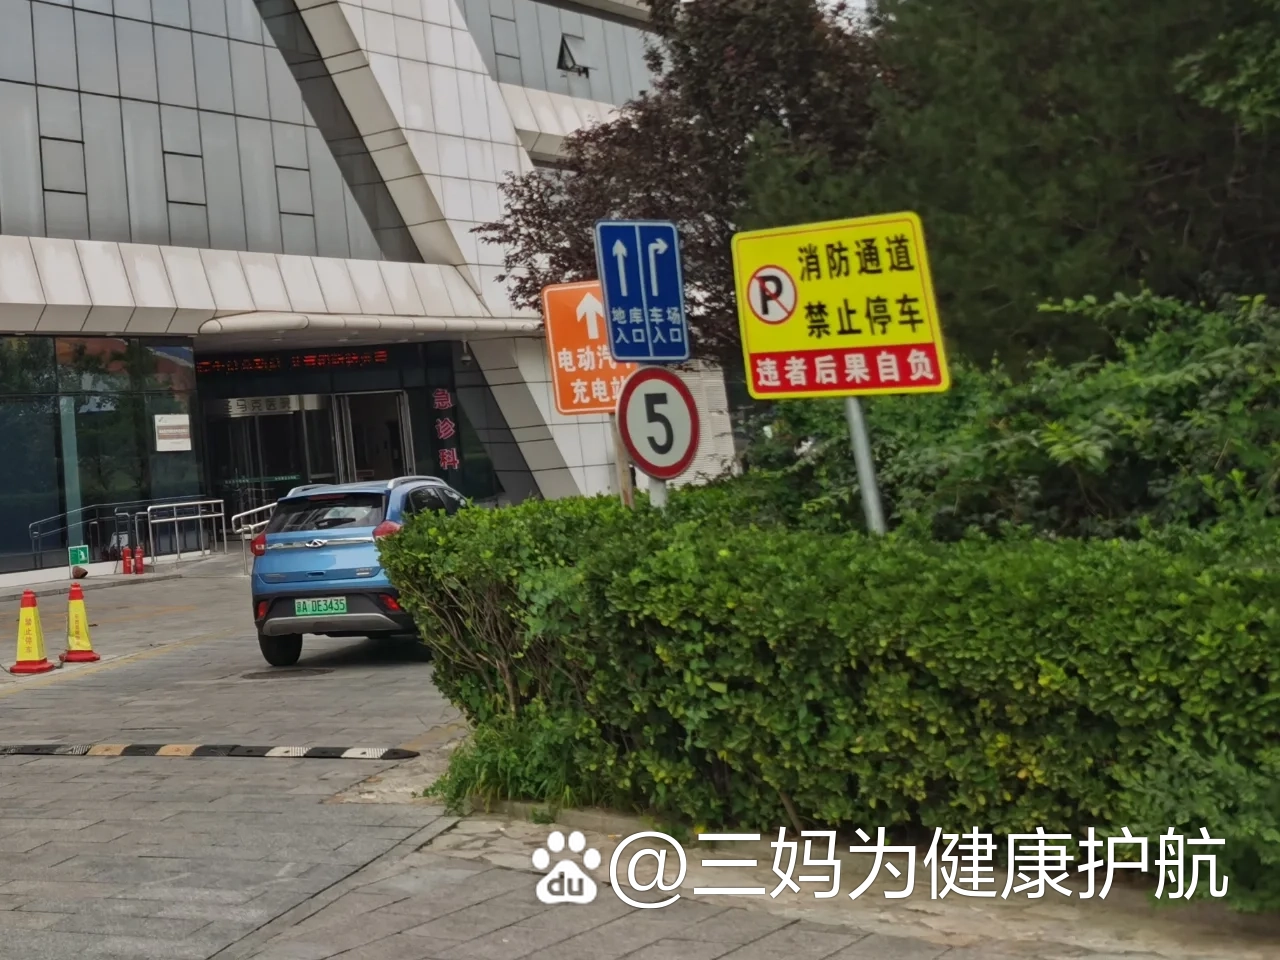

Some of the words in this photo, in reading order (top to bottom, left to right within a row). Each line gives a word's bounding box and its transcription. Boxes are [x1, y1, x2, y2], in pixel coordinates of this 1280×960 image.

[797, 233, 915, 282] 消防通道
[612, 306, 644, 325] 地库
[649, 306, 682, 326] 车场
[804, 292, 924, 340] 禁止停车
[615, 327, 645, 344] 入口
[652, 327, 683, 344] 入口
[557, 345, 632, 372] 电动汽
[756, 348, 935, 388] 违者后果自负
[432, 388, 460, 470] 急诊科
[644, 392, 674, 455] 5
